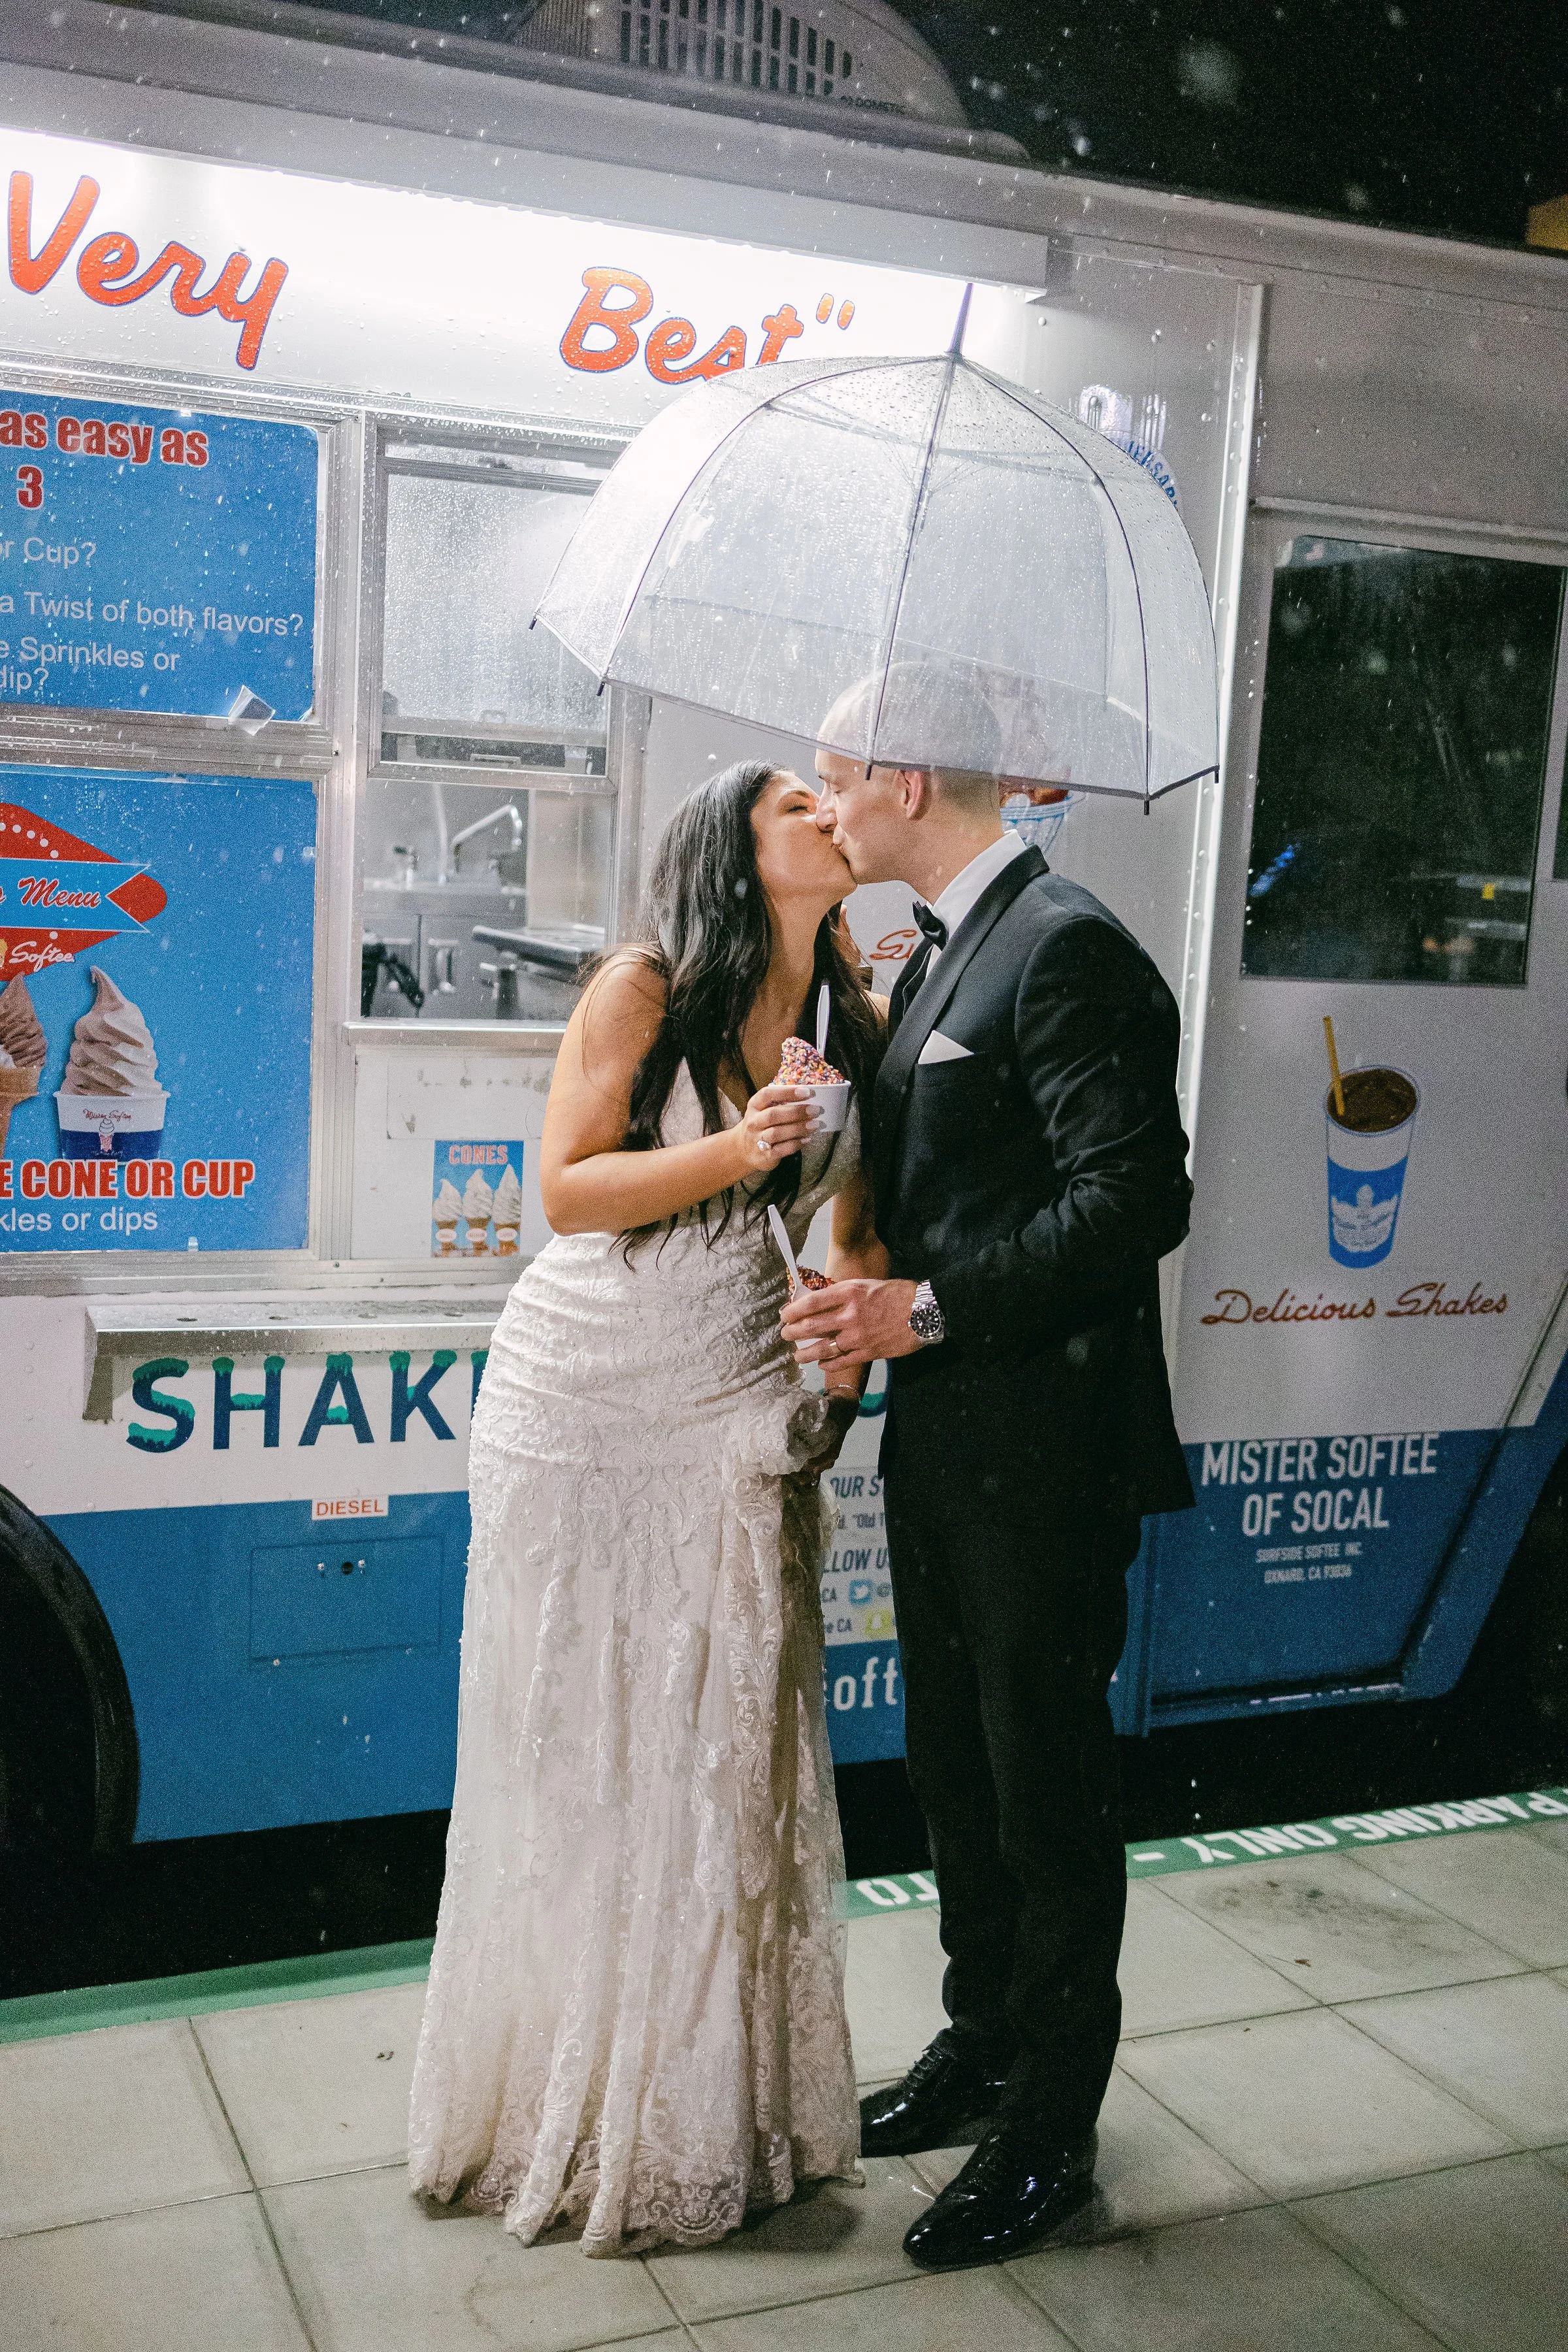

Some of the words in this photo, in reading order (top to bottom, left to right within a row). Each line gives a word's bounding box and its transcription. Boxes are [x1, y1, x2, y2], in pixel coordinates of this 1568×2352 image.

[8, 171, 289, 370] Very
[0, 408, 48, 450] as
[56, 416, 154, 465] easy
[160, 427, 210, 468] as
[16, 464, 44, 511] 3
[0, 541, 14, 558] r
[24, 537, 97, 569] Cup?
[0, 595, 14, 613] a
[24, 591, 93, 621] Twist
[103, 599, 129, 623] of
[137, 601, 194, 629] both
[203, 606, 304, 636] flavors?
[20, 636, 145, 669] Sprinkles
[154, 652, 180, 671] or
[18, 876, 101, 908] Menu
[8, 940, 75, 973] Softee
[448, 1145, 508, 1165] CONES
[21, 1159, 119, 1199] CONE
[125, 1159, 175, 1198] OR
[182, 1159, 255, 1199] CUP
[62, 1211, 91, 1231] or
[99, 1205, 158, 1236] dips
[1200, 1288, 1377, 1325] Delicious
[1385, 1281, 1509, 1318] Shakes
[1201, 1437, 1318, 1486] MISTER
[1327, 1432, 1438, 1480] SOFTEE
[316, 1499, 384, 1517] DIESEL
[1242, 1492, 1284, 1537] OF
[1291, 1487, 1390, 1533] SOCAL
[1330, 1792, 1568, 1840] PARKING
[1181, 1823, 1339, 1863] ONLY
